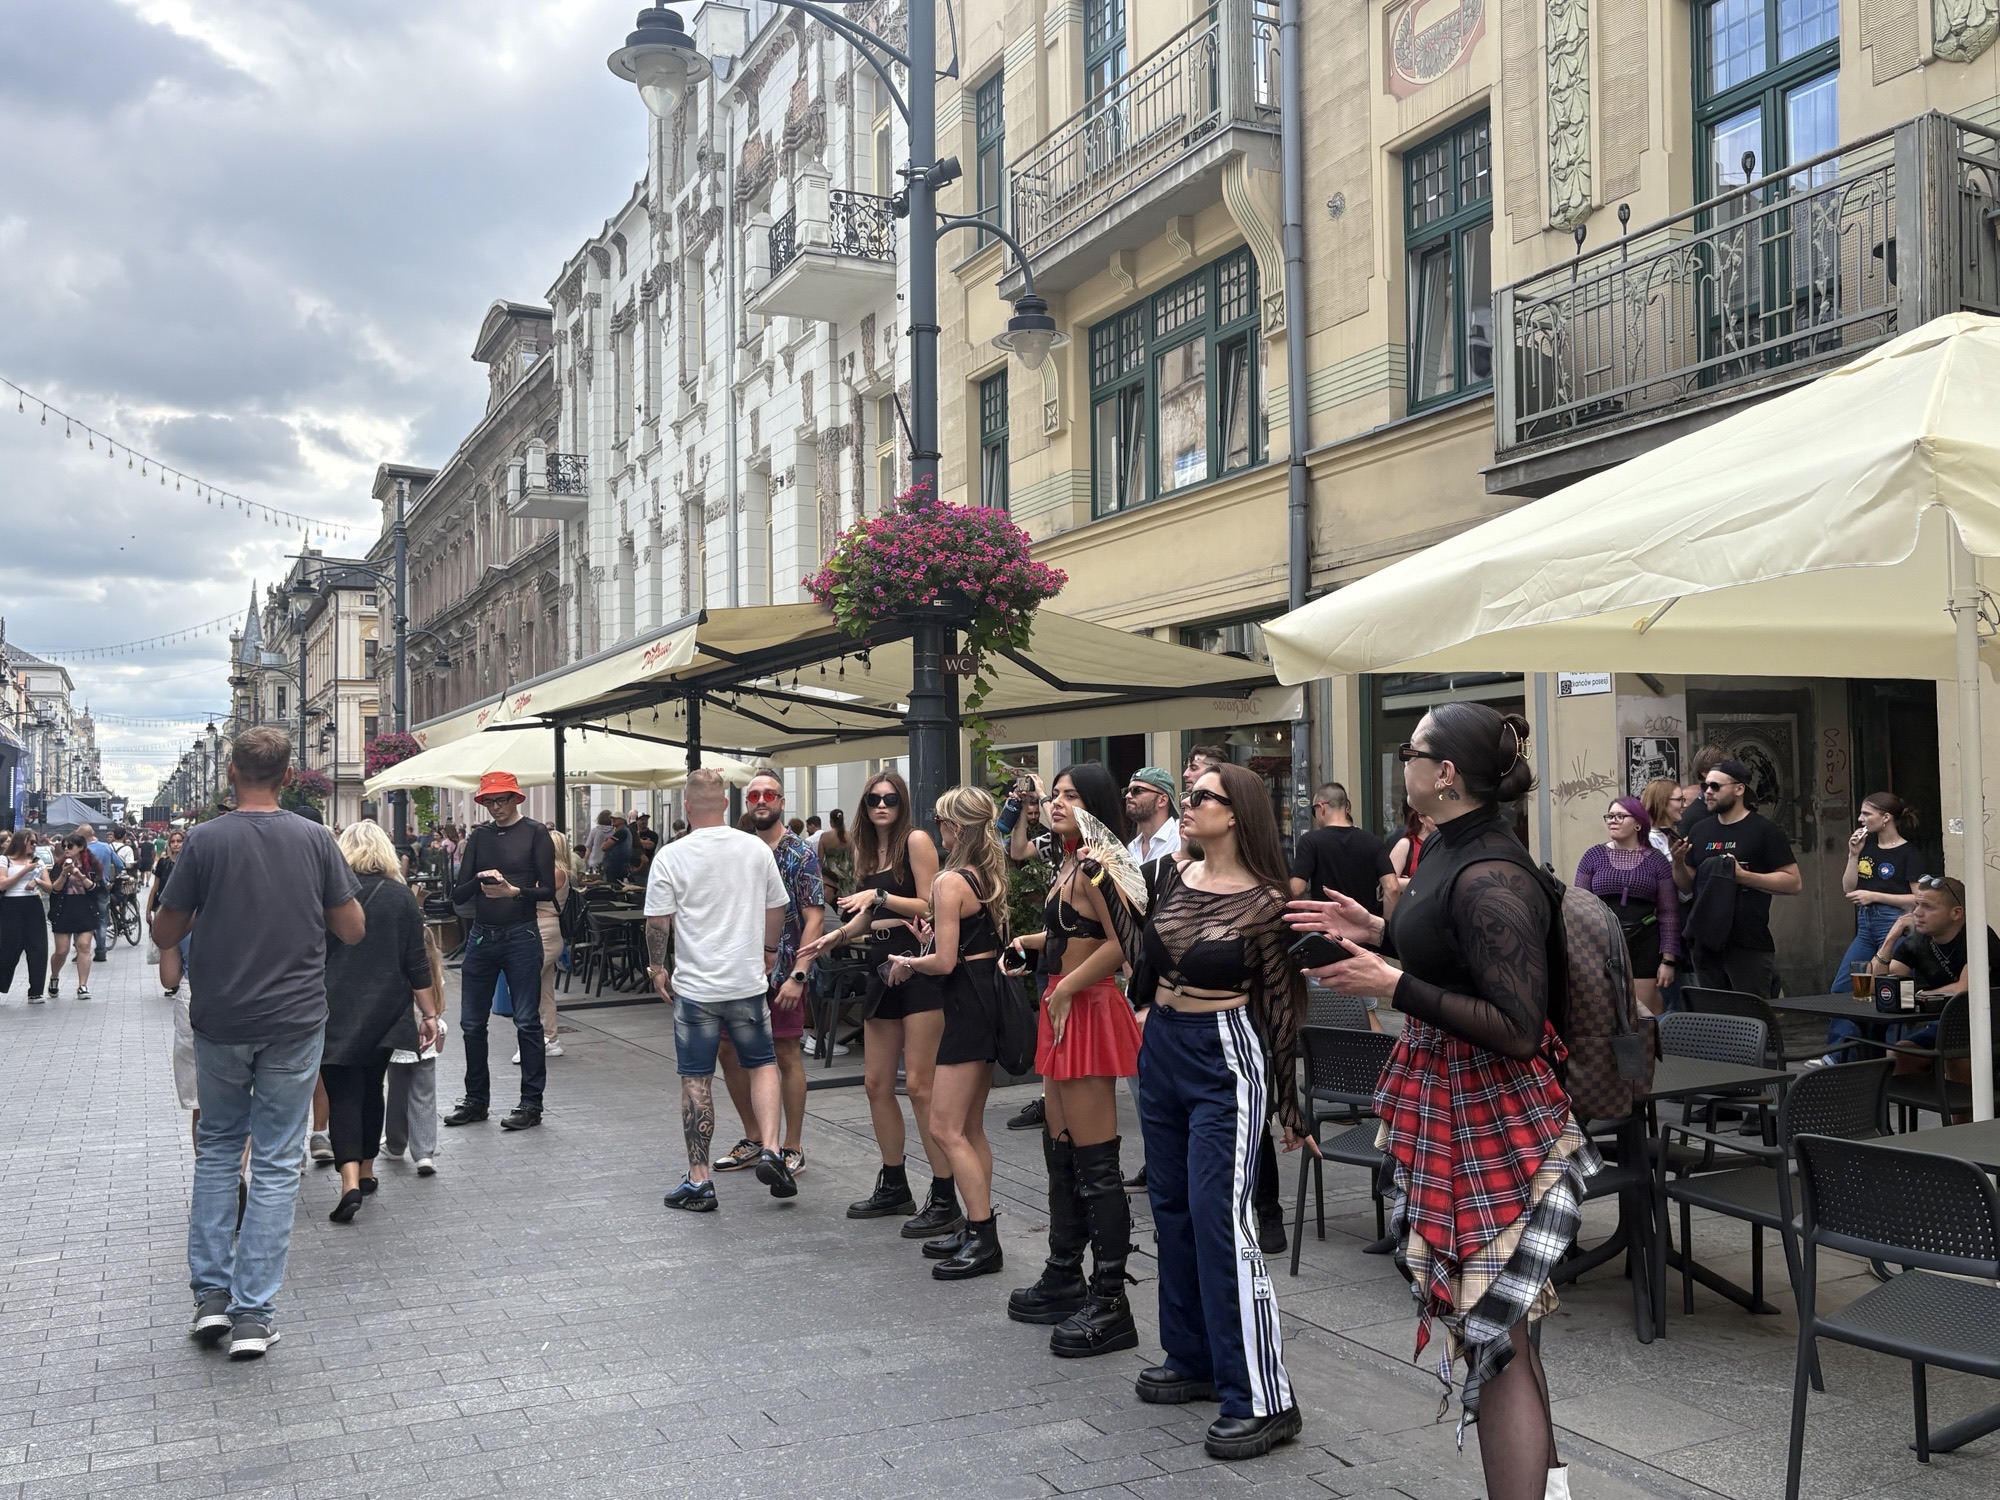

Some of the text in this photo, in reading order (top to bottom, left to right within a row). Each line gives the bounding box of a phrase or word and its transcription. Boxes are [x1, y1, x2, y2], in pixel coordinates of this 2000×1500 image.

[945, 658, 970, 671] WC
[1645, 716, 1682, 733] SCOT
[699, 1121, 713, 1136] 66
